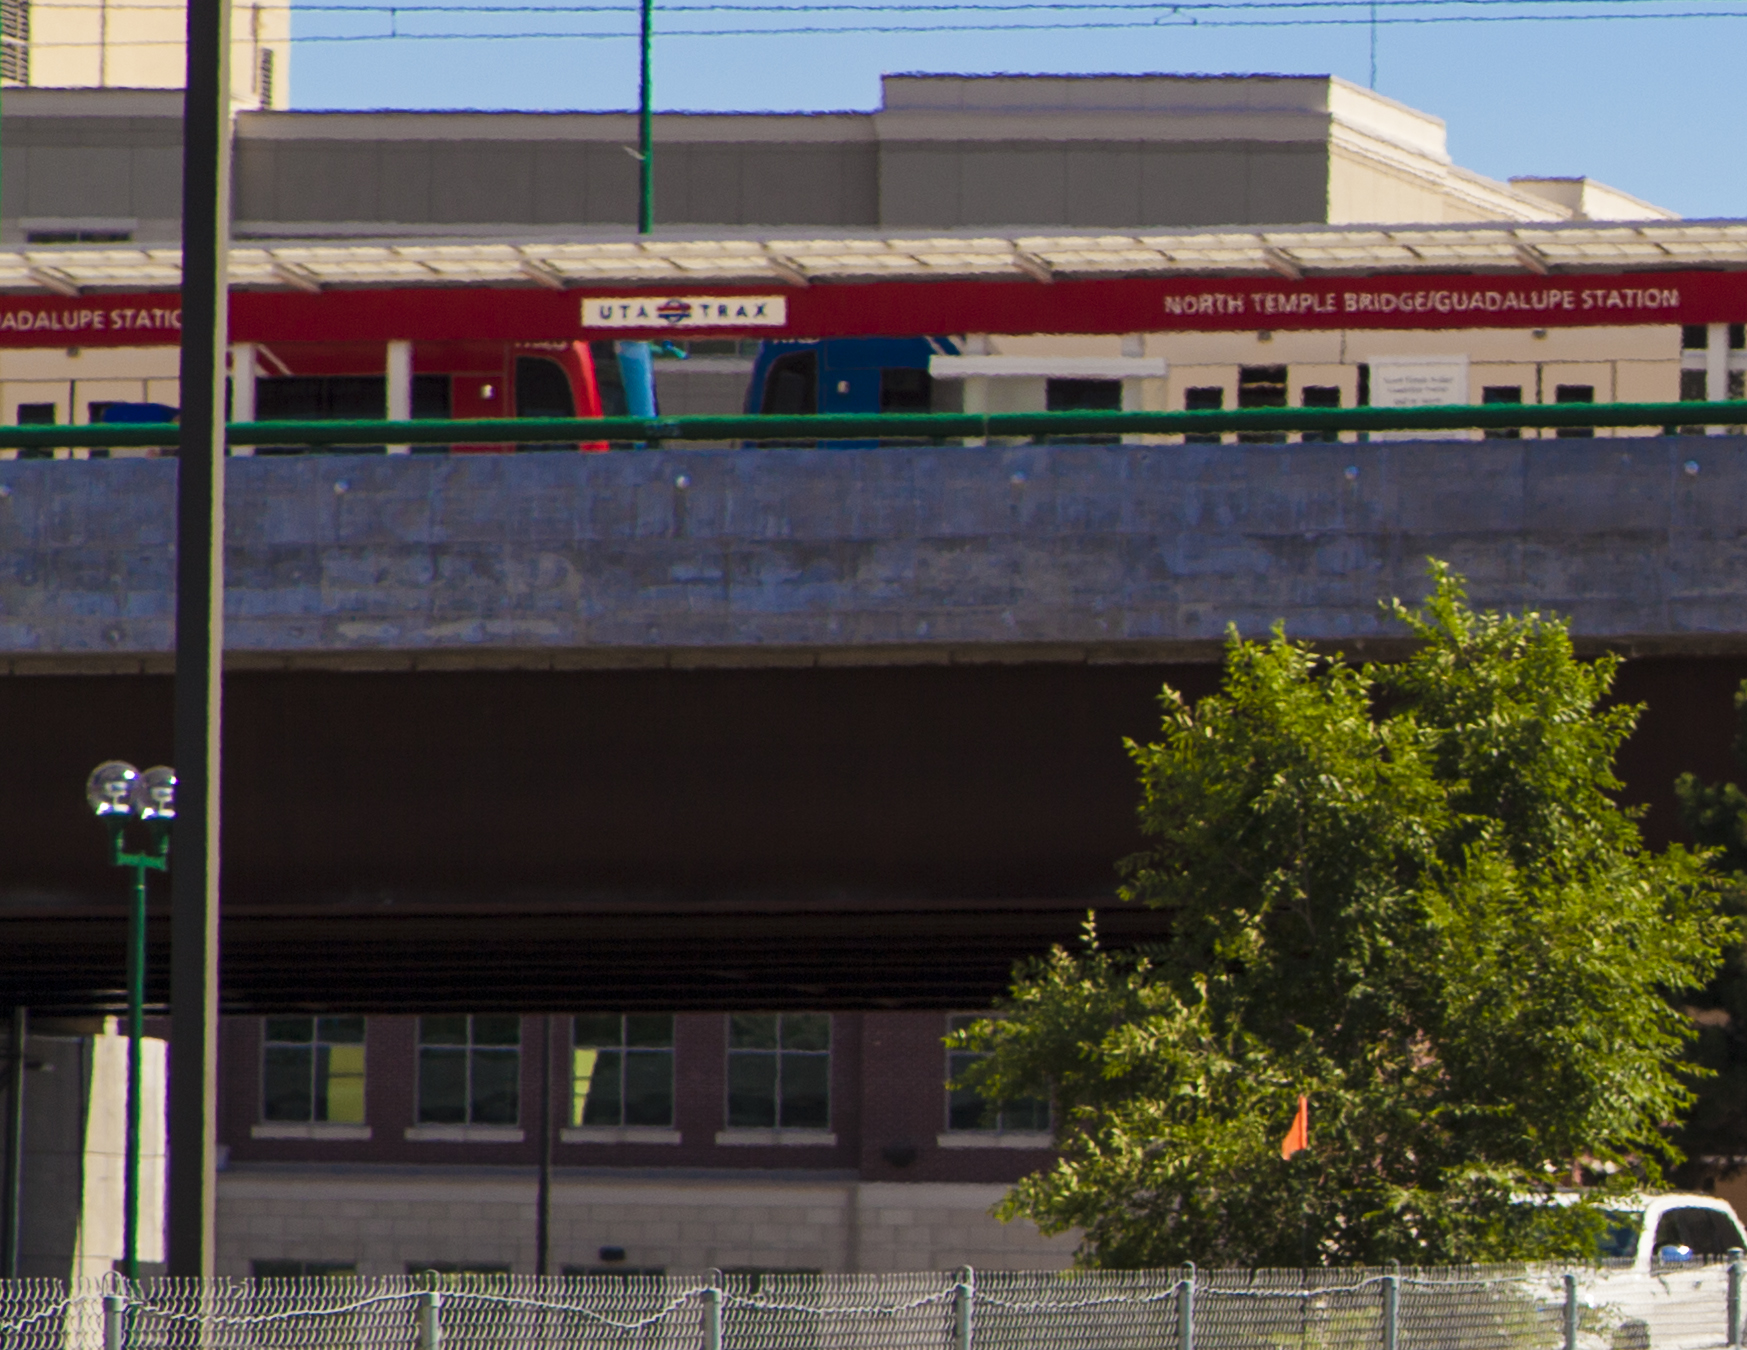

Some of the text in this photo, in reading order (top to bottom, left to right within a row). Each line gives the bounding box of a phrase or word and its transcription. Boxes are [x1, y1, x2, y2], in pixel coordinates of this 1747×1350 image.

[600, 303, 768, 319] UTA TRAX
[1164, 288, 1681, 314] NORTH TEMPLE BRIDGE/GUADALUPE STATION
